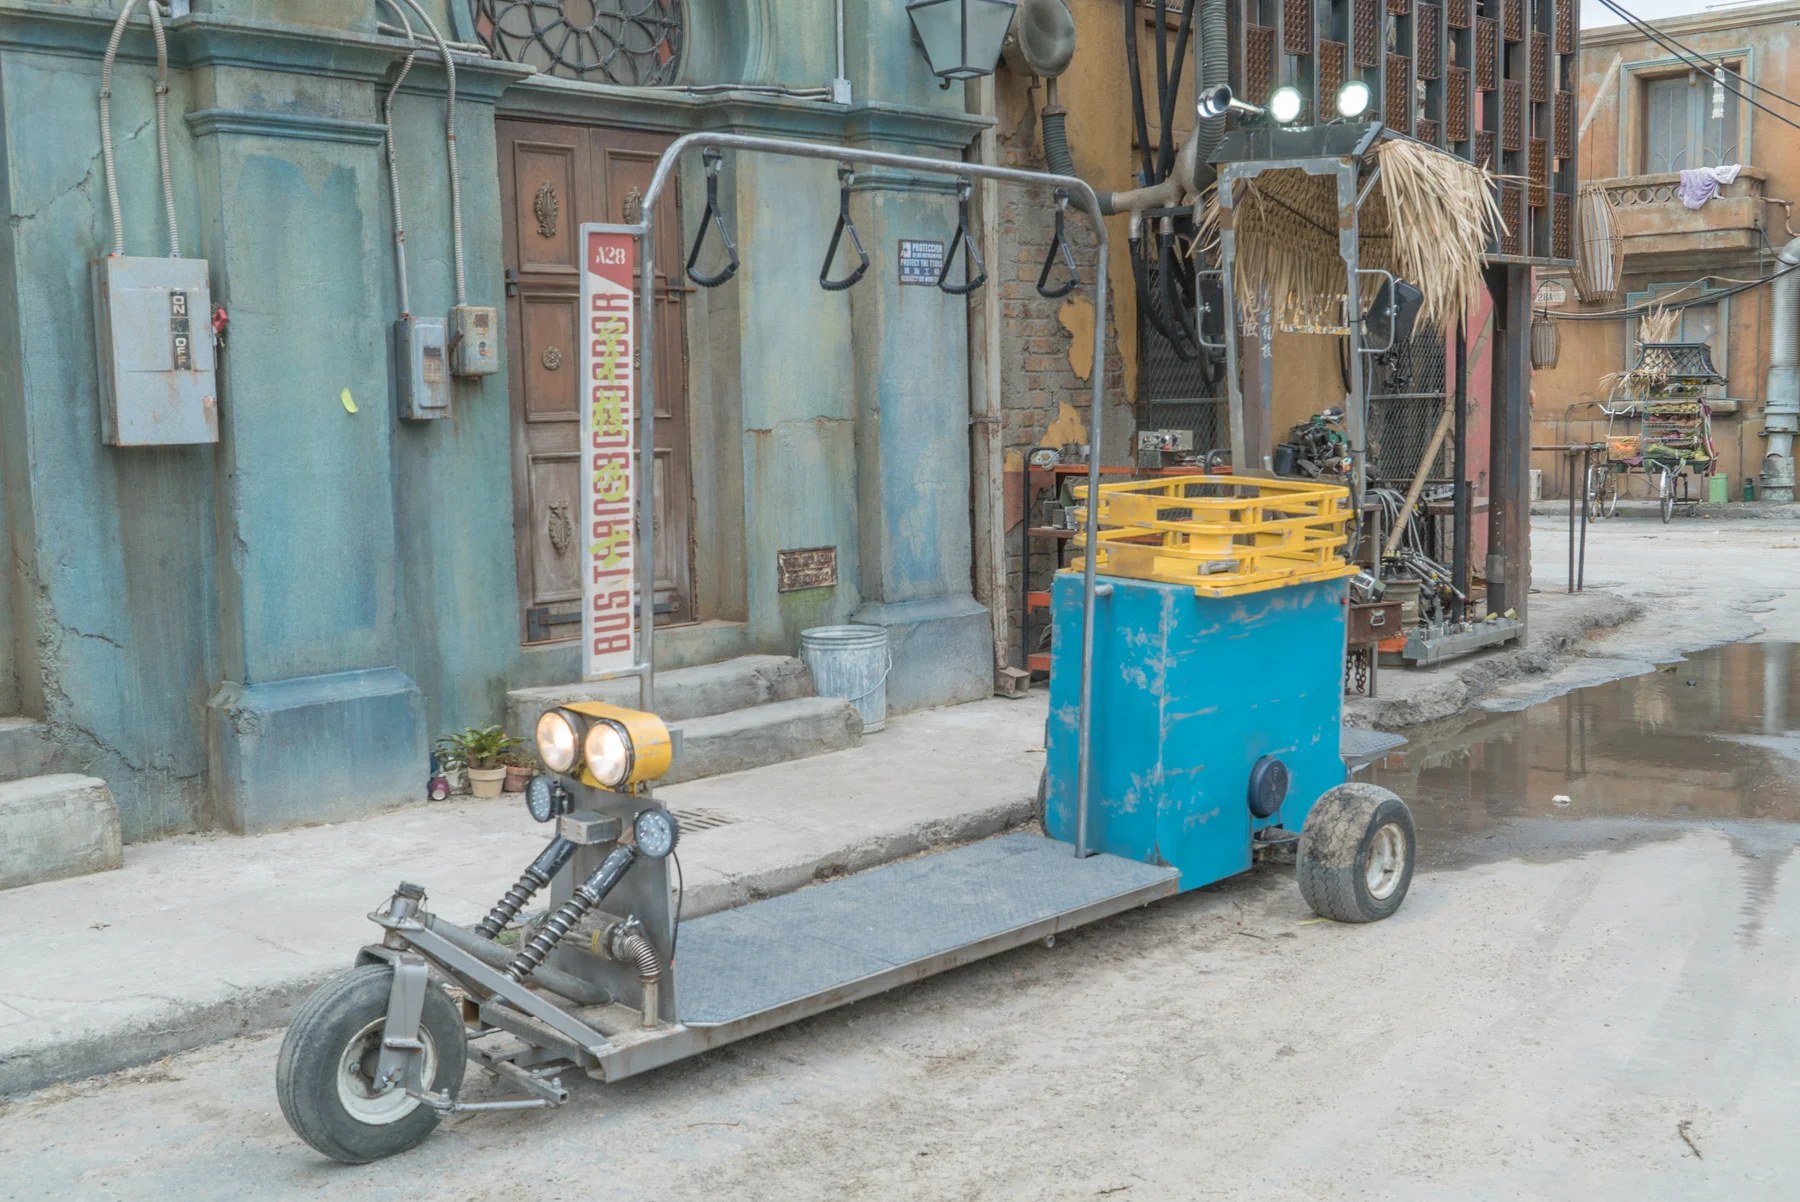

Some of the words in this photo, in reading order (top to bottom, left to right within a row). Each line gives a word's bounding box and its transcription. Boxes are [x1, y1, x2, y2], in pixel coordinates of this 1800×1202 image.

[172, 295, 186, 315] ON
[174, 337, 187, 365] OFF
[593, 590, 631, 656] BUS
